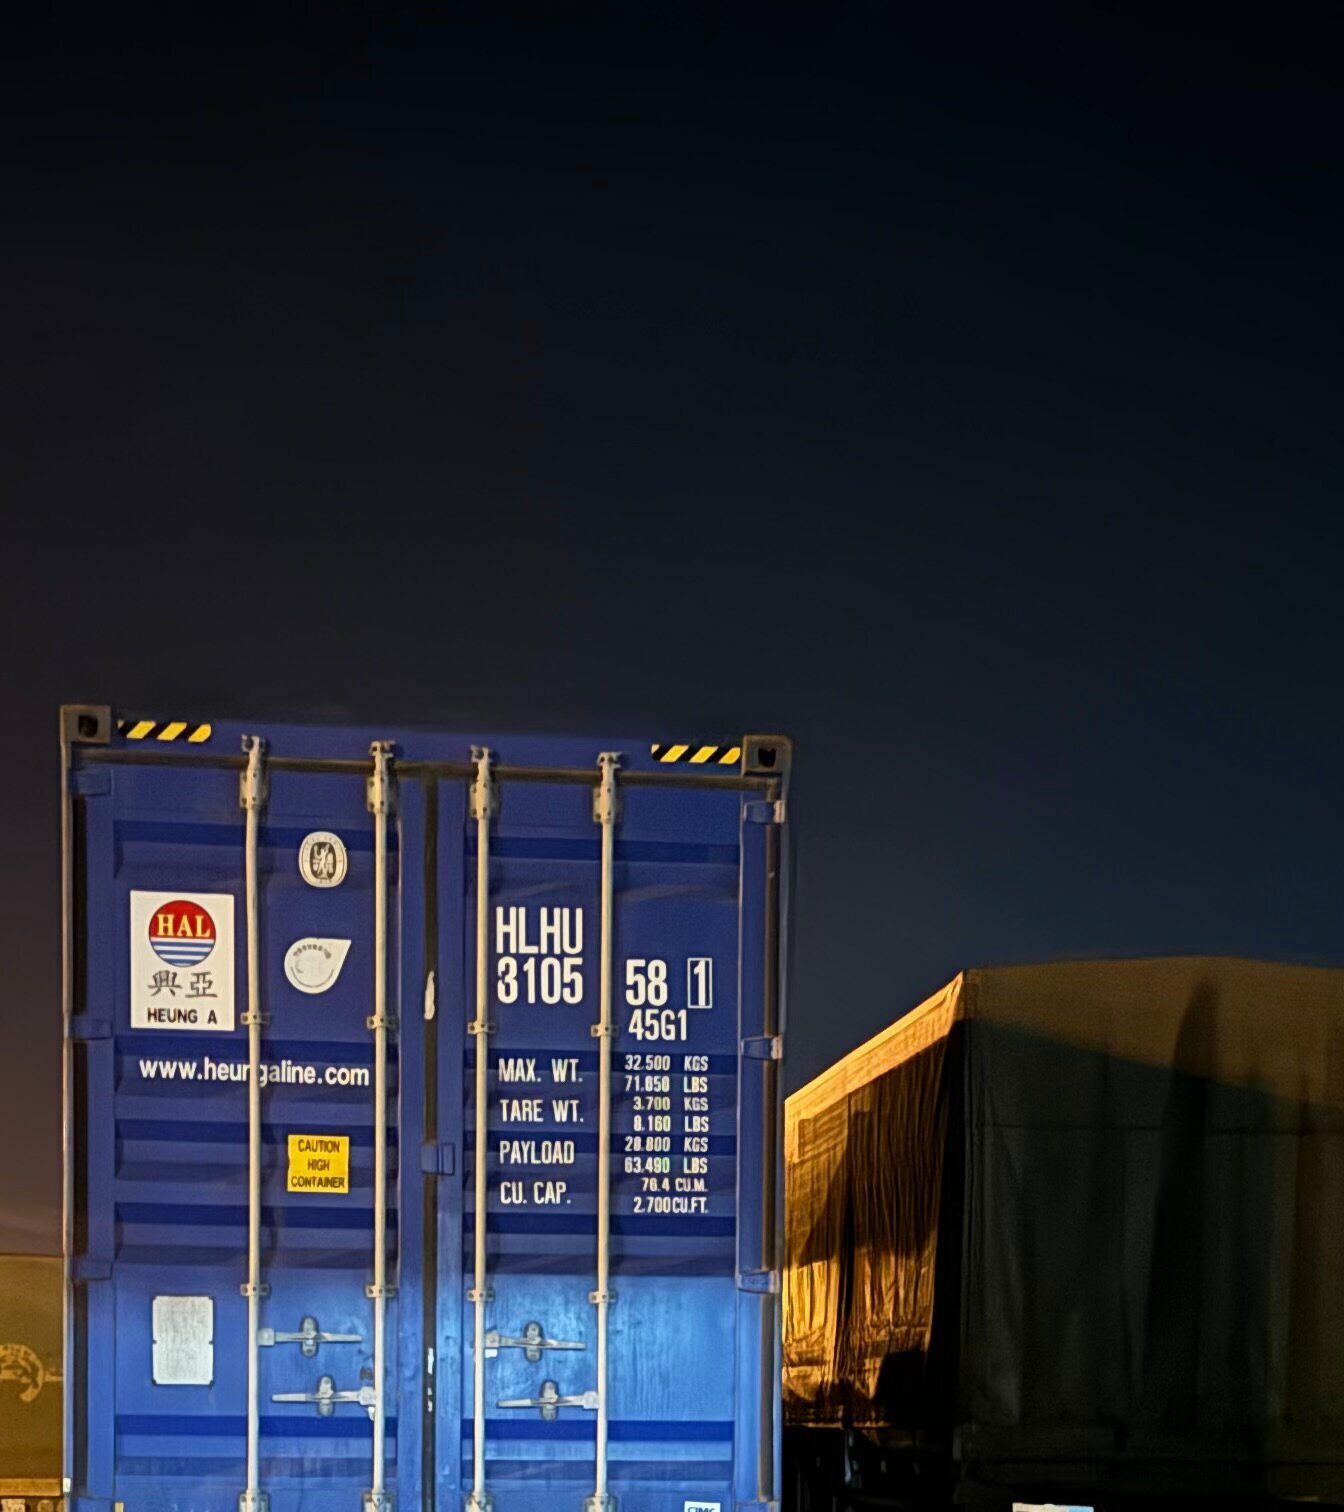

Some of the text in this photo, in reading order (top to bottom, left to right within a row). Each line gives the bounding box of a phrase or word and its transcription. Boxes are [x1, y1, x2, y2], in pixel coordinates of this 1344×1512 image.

[156, 913, 211, 938] HAL
[495, 906, 584, 955] HLHU
[147, 969, 218, 999] 興亞
[496, 956, 584, 1004] 3105
[625, 958, 668, 1006] 58
[146, 1007, 218, 1025] HEUNG A
[628, 1008, 688, 1041] 45G1
[498, 1058, 584, 1083] MAX. WT.
[624, 1054, 709, 1072] 32.500 KGS
[683, 1075, 708, 1093] LBS
[499, 1099, 585, 1123] TARE WT.
[632, 1095, 709, 1112] 3.700 KGS
[684, 1115, 709, 1133] LBS
[297, 1138, 341, 1154] CAUTION
[499, 1140, 576, 1165] PAYLOAD
[684, 1136, 709, 1153] KGS
[307, 1158, 331, 1172] HIGH
[683, 1156, 708, 1174] LBS
[291, 1175, 345, 1189] CONTAINER
[500, 1181, 572, 1205] CU. CAP.
